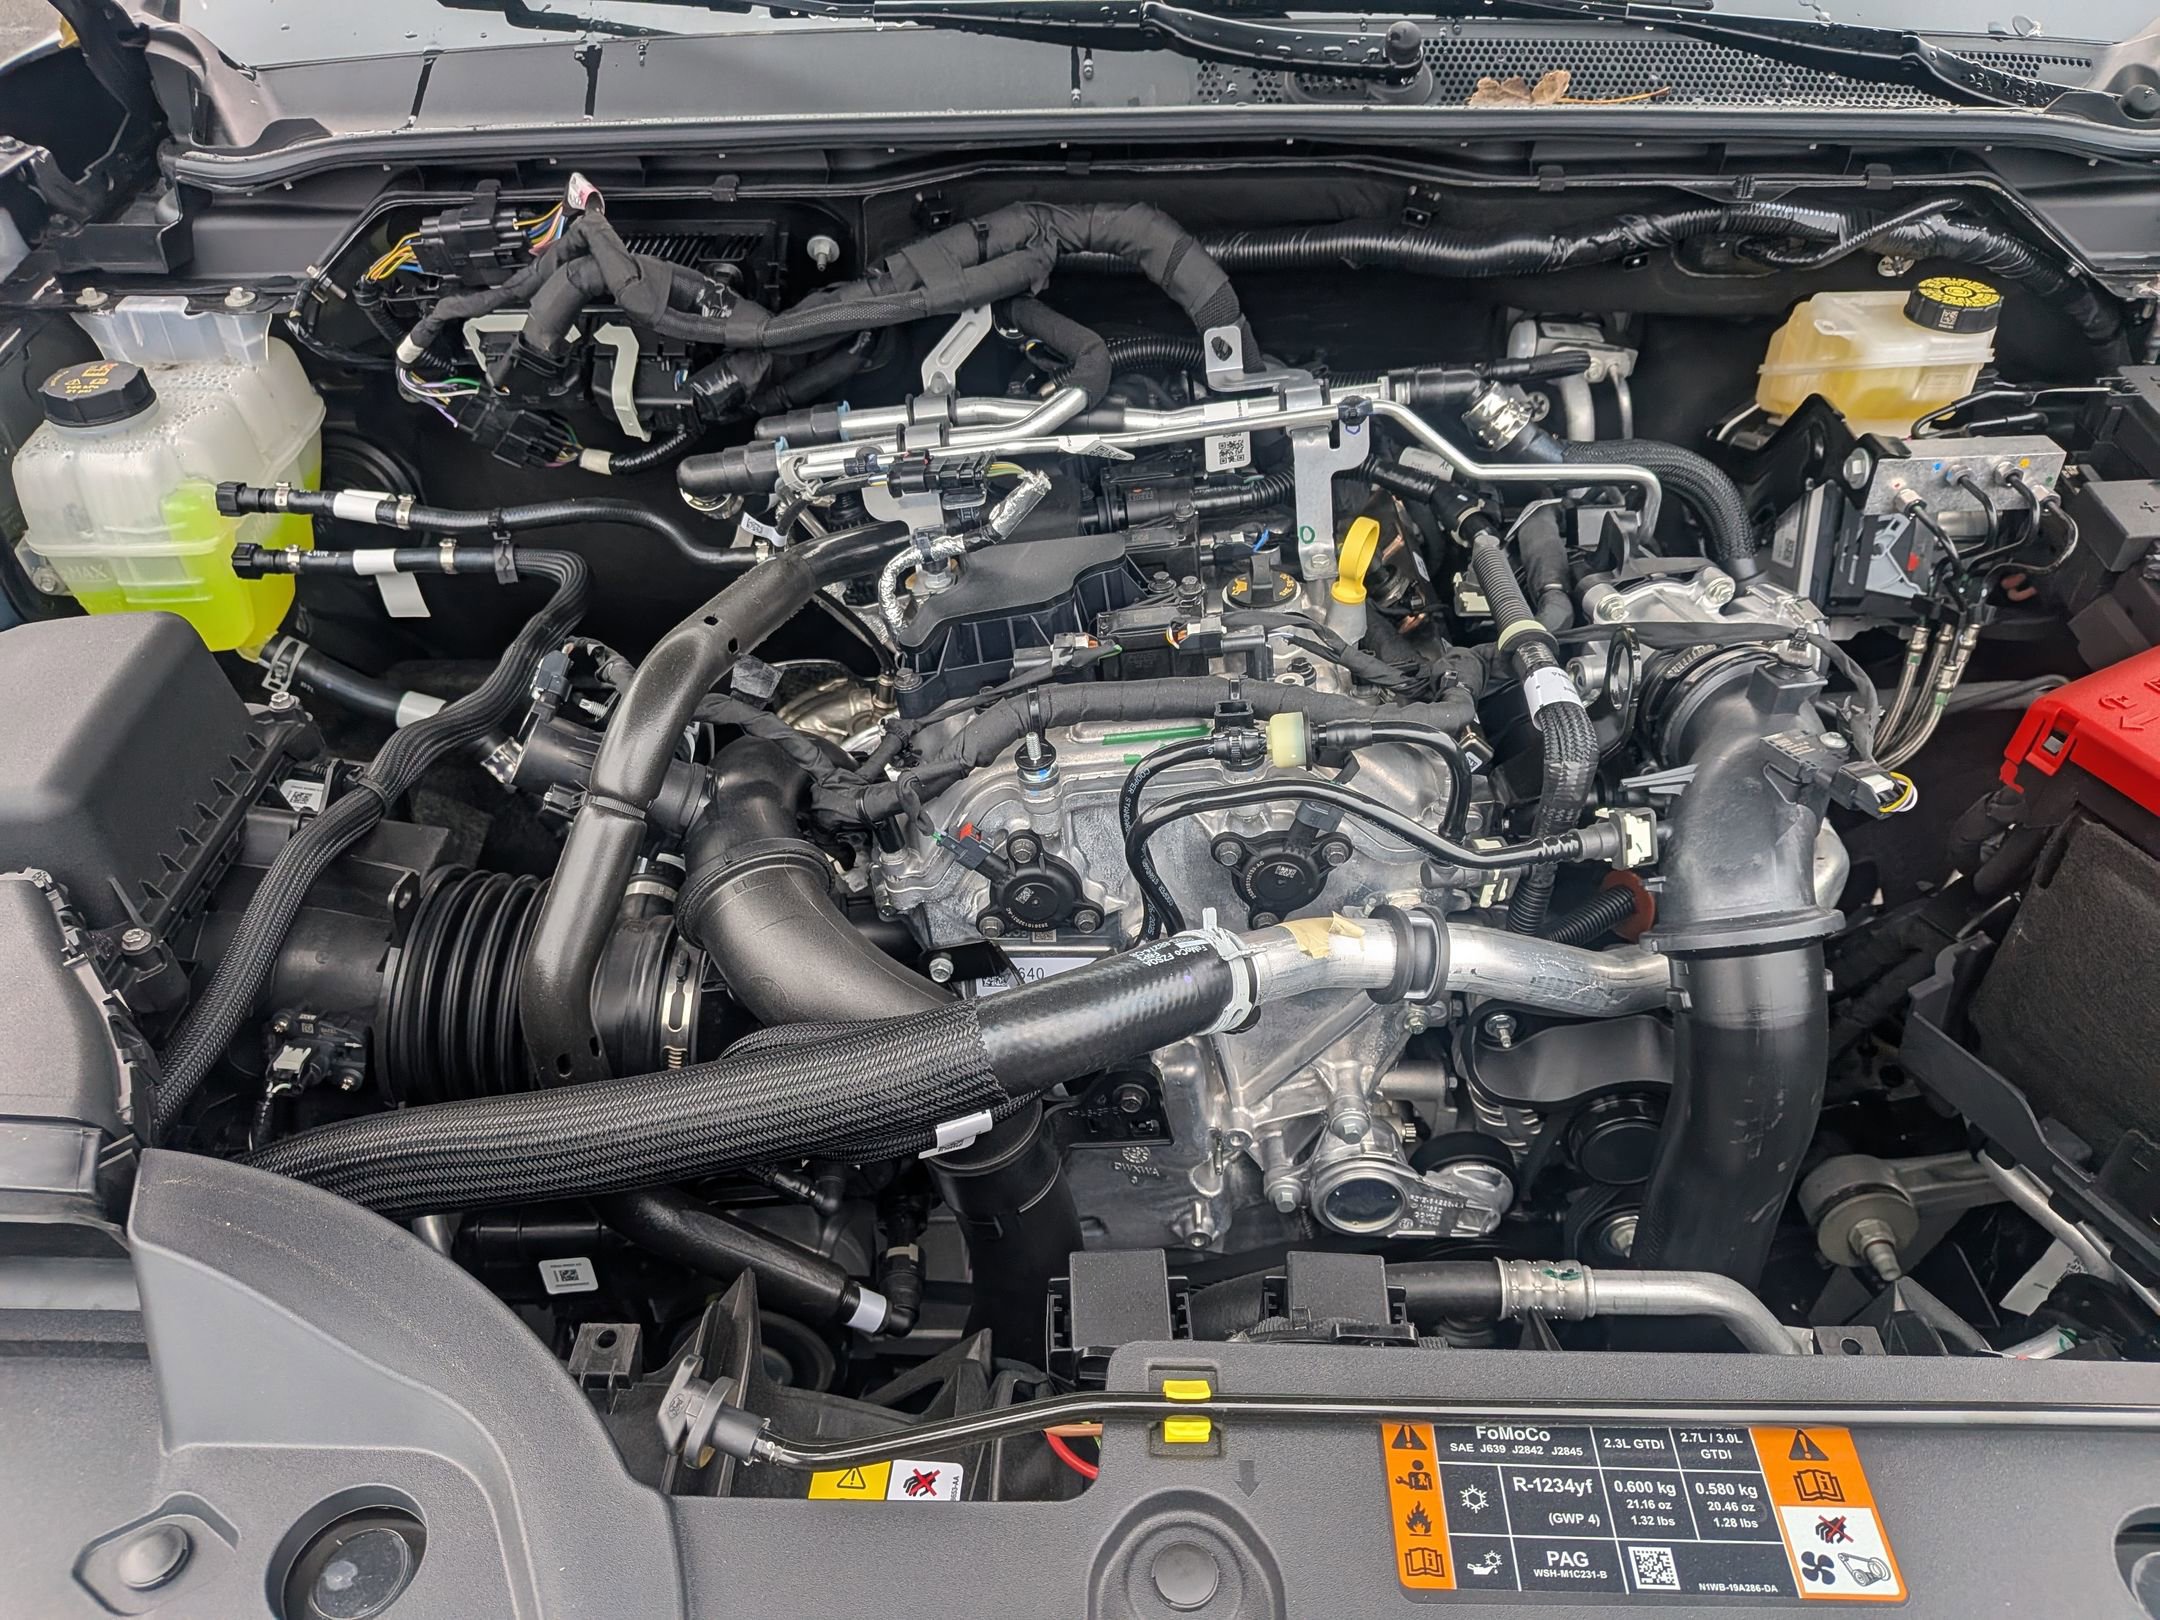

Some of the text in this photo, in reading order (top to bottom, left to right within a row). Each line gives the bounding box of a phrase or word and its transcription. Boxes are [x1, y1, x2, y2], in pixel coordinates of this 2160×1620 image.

[1122, 767, 1151, 832] COOPER STANDAR
[1476, 1426, 1551, 1442] FoMoCo
[1680, 1432, 1708, 1443] 2.7L
[1716, 1433, 1744, 1445] 3.0L
[1450, 1443, 1584, 1457] SAE J639 J2842 J2845
[1603, 1438, 1665, 1450] 2.3L GTDI
[1700, 1449, 1732, 1460] GTDI
[1512, 1476, 1593, 1497] R-1234yf
[1613, 1480, 1677, 1497] 0.600 kg
[1695, 1482, 1759, 1499] 0.580 kg
[1626, 1499, 1673, 1510] 21.16 oz
[1706, 1501, 1756, 1512] 20.46 oz
[1548, 1512, 1601, 1528] (GWP 4)
[1630, 1515, 1676, 1526] 1.32 lbs
[1713, 1517, 1759, 1528] 1.28 lbs
[1546, 1550, 1590, 1568] PAG
[1533, 1568, 1608, 1579] WSH-M1C231-B
[1698, 1582, 1779, 1593] N1WB-19A286-DA
